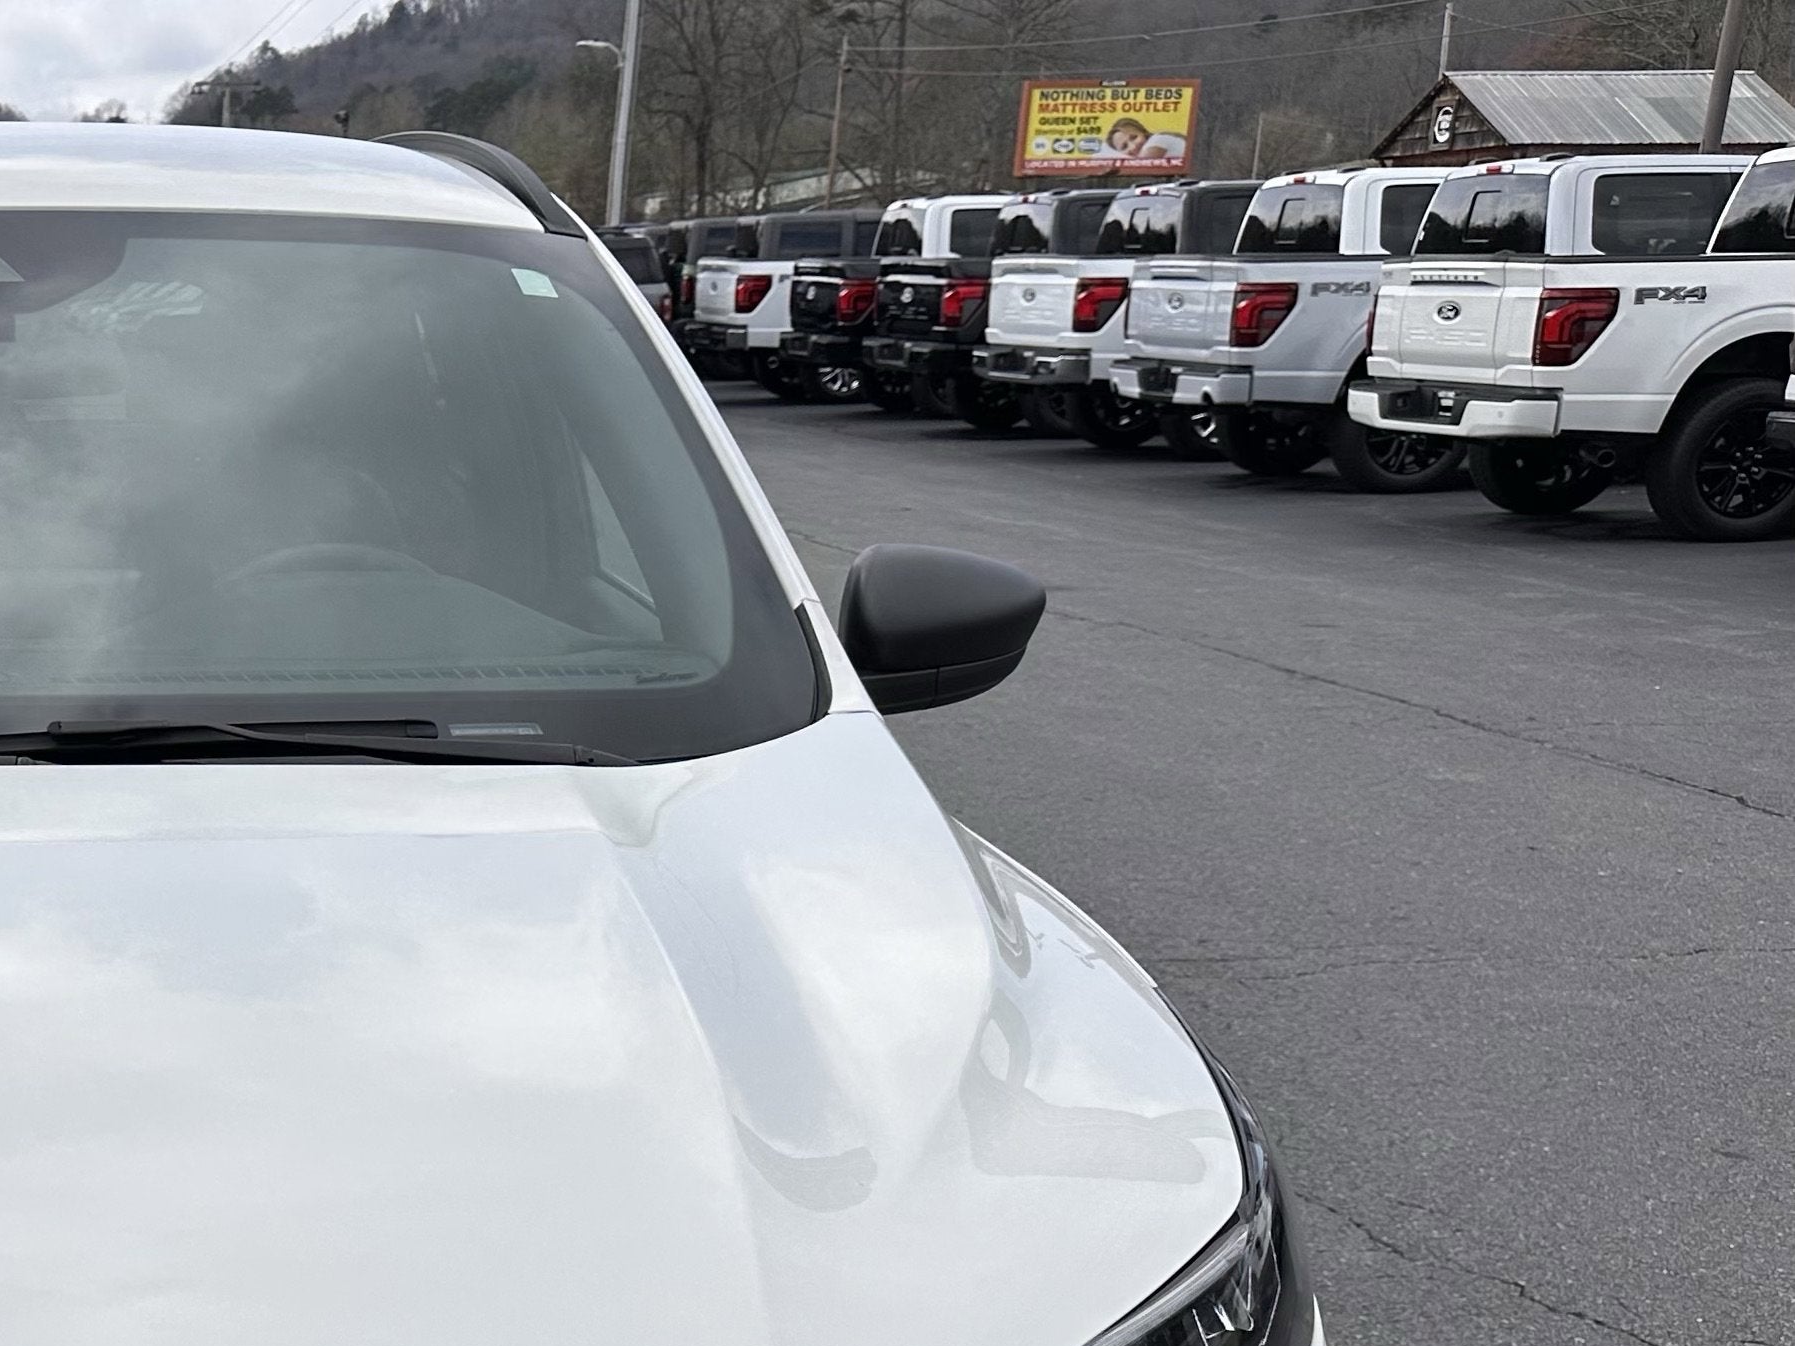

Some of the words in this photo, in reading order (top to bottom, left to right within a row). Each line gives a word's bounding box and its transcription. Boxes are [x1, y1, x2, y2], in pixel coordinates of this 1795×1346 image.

[1039, 89, 1106, 101] NOTHING
[1111, 89, 1140, 100] BUT
[1145, 88, 1182, 100] BEDS
[1038, 102, 1117, 113] MATTRESS
[1122, 101, 1180, 112] OUTLET
[1038, 116, 1076, 126] QUEEN
[1079, 116, 1099, 125] SET
[1310, 282, 1371, 297] FX4
[1634, 286, 1707, 304] FX4
